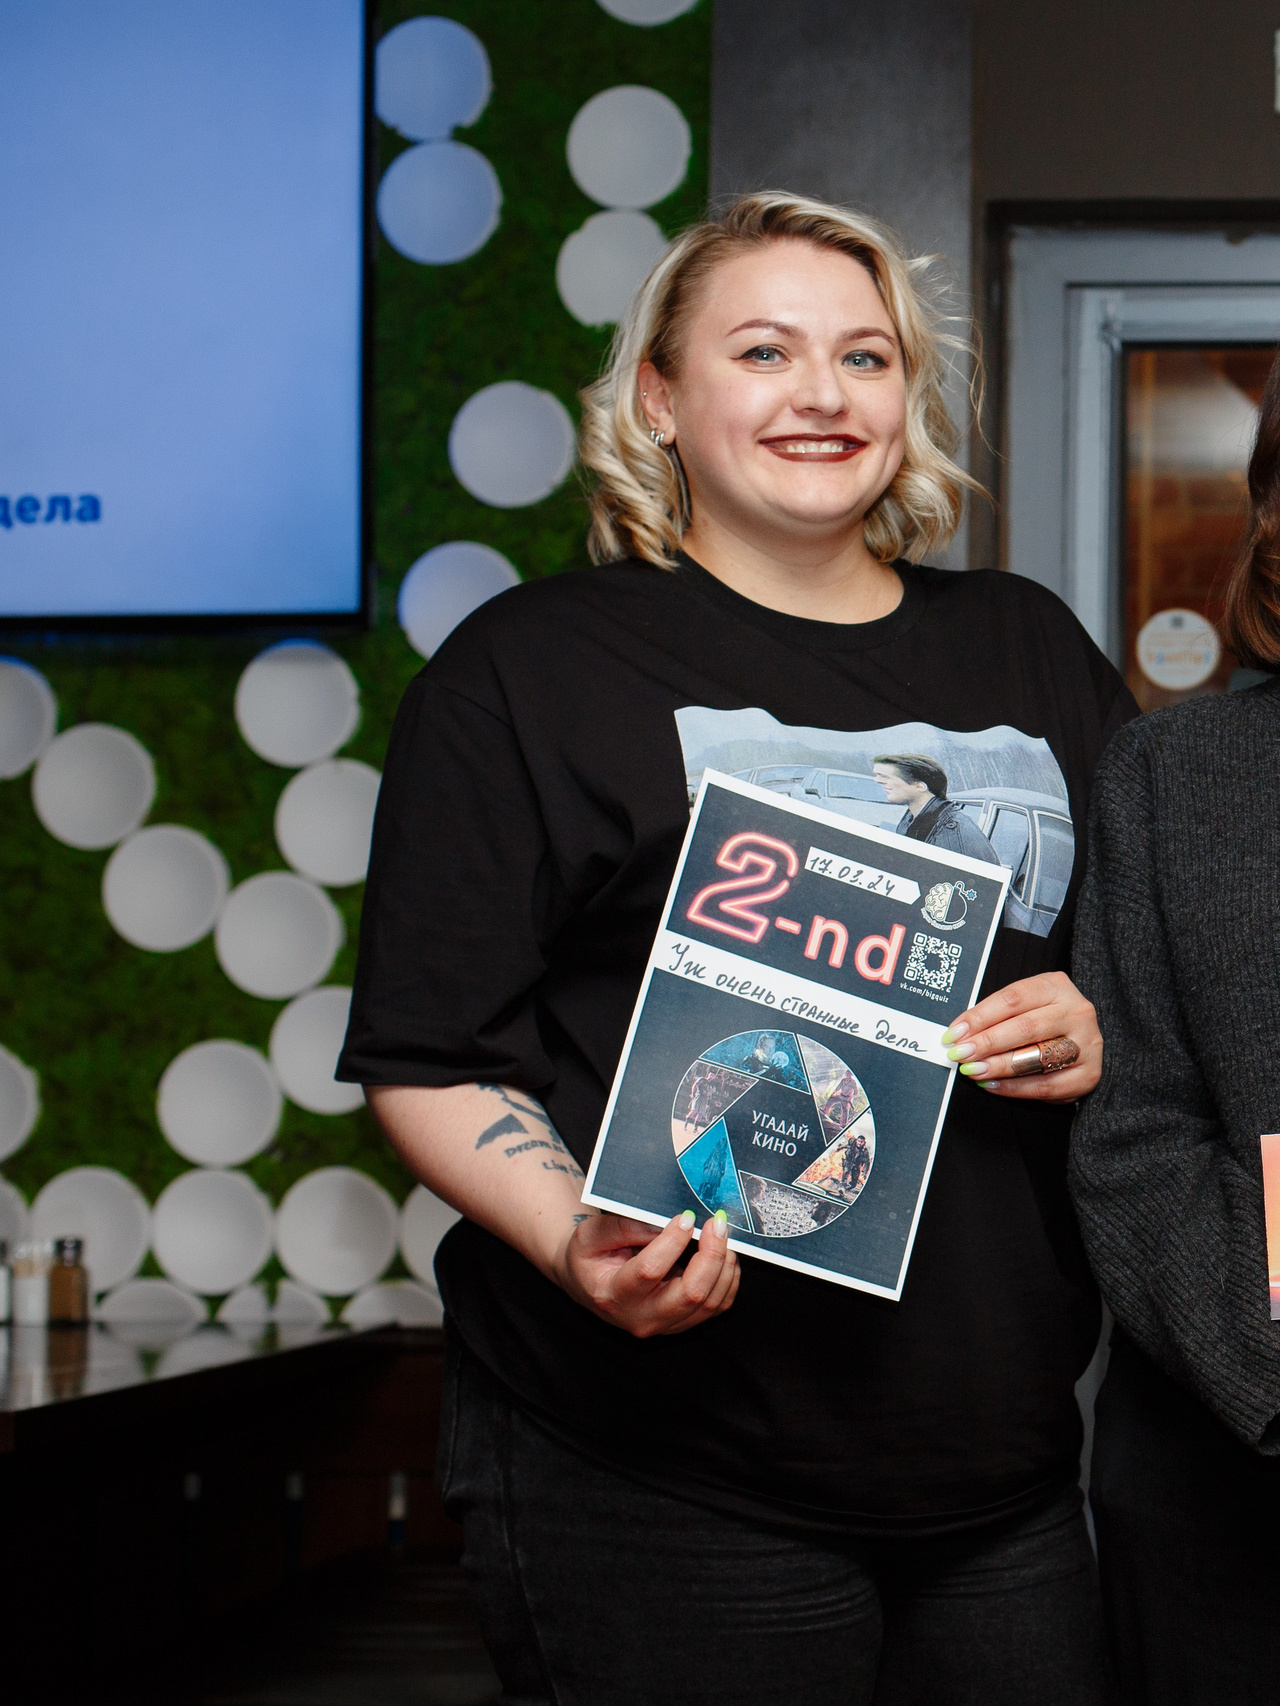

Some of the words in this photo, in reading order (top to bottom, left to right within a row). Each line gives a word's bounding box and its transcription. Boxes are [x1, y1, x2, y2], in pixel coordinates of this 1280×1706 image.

[809, 855, 895, 897] 17.03.24
[686, 831, 906, 985] 2-nd
[669, 943, 706, 978] Уж
[716, 974, 776, 1005] очень
[875, 1019, 928, 1053] дела
[899, 981, 950, 1003] vk.com/bigquiz
[752, 1110, 809, 1141] УГАДАЙ
[752, 1131, 797, 1156] КИНО
